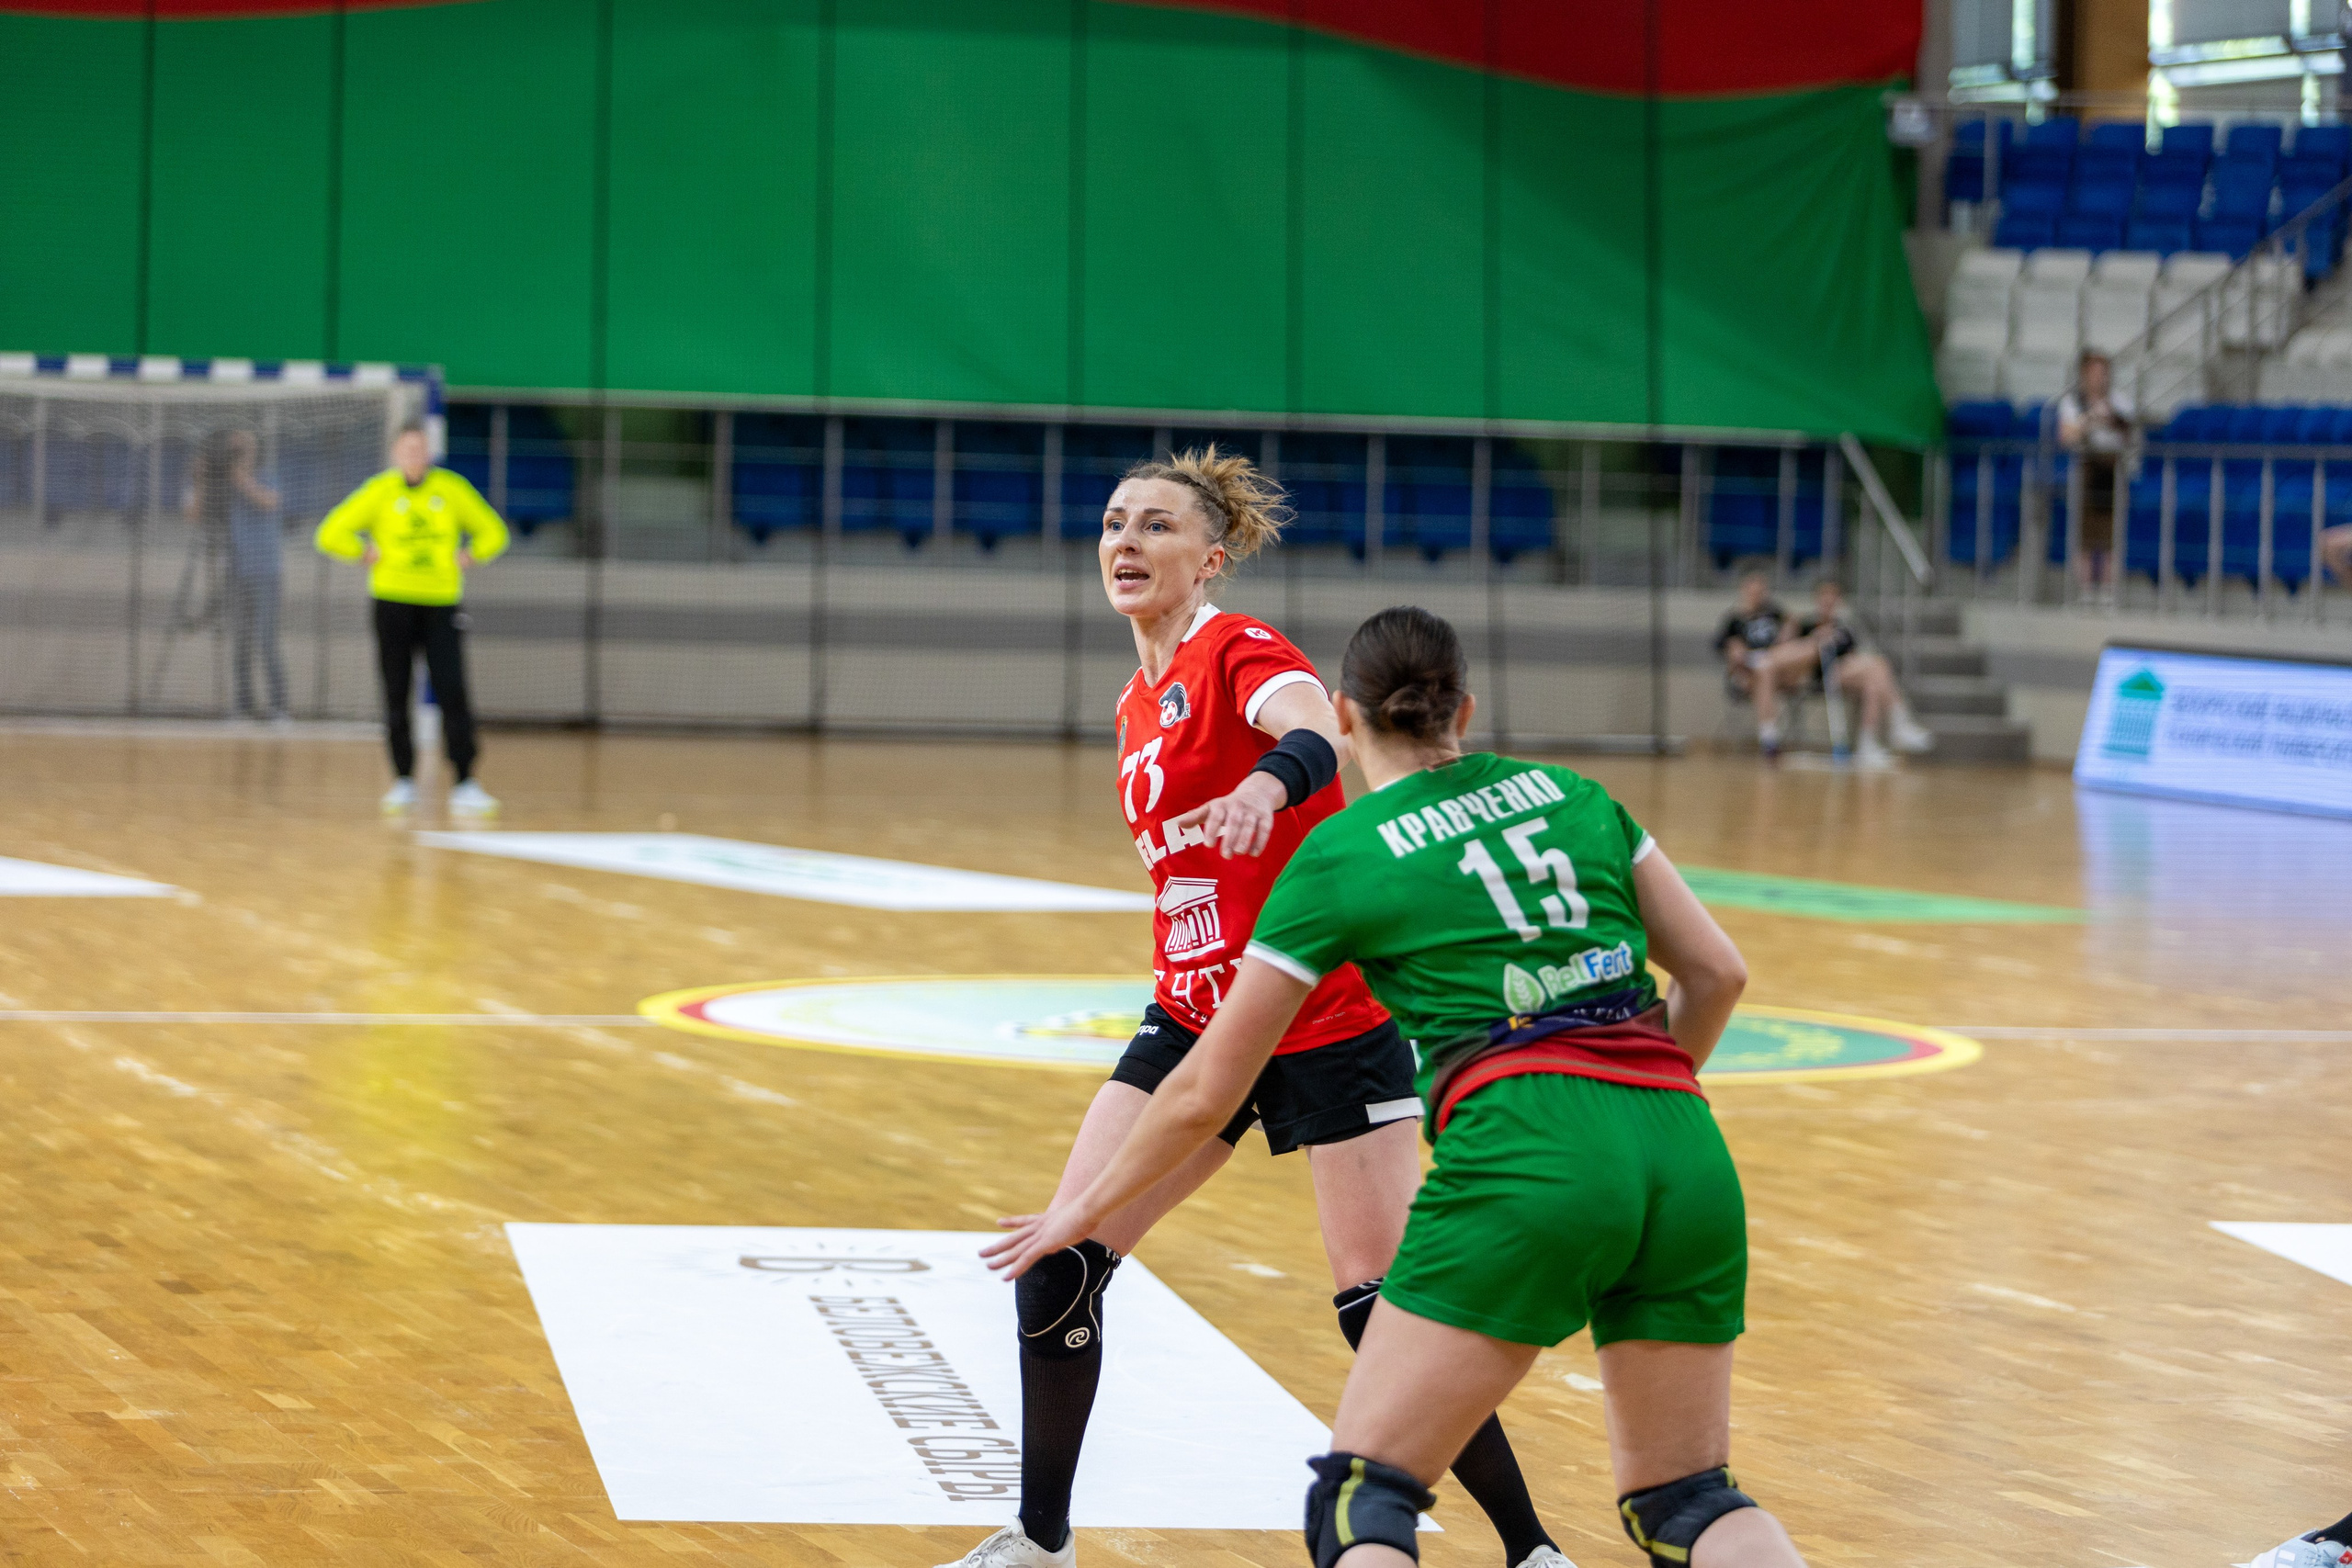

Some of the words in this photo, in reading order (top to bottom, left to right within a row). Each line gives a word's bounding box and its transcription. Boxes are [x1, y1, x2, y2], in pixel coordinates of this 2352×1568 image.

[1120, 736, 1164, 823] 73
[1376, 769, 1566, 858] КРАВЧЕНКО
[1457, 817, 1589, 942] 15
[1538, 942, 1633, 998] BelFert
[808, 1295, 1001, 1429] БЕЛОВЕЖСКИЕ
[907, 1436, 1022, 1502] СЫРЫ
